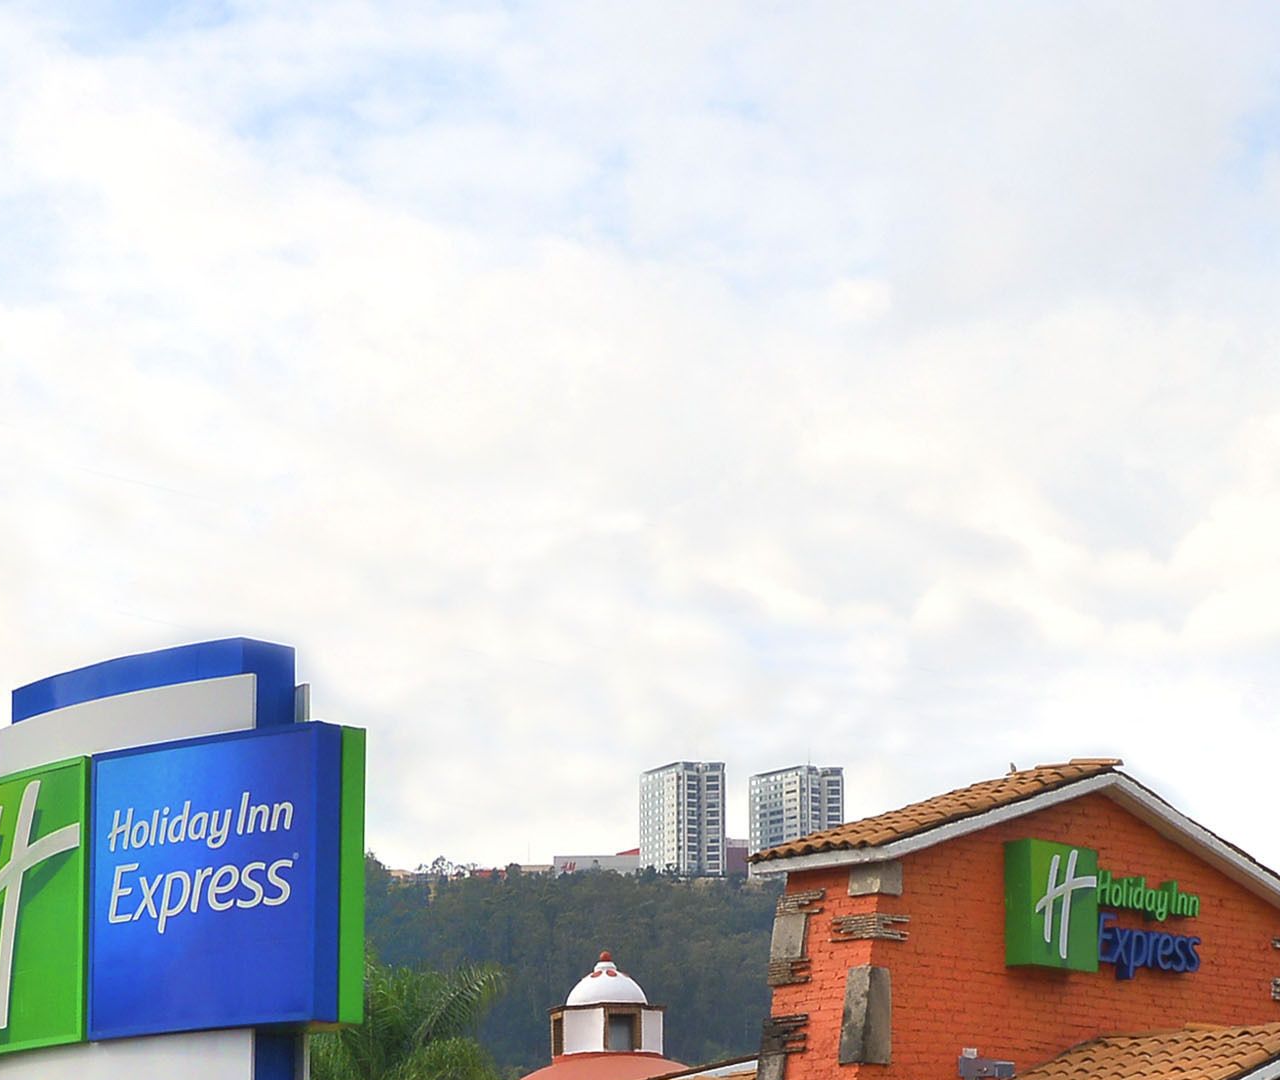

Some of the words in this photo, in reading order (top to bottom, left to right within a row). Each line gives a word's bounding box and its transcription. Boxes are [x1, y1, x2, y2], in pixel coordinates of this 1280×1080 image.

[108, 801, 233, 850] Holiday
[237, 792, 294, 835] Inn
[108, 858, 294, 934] Express
[1097, 869, 1168, 921] Holiday
[1169, 881, 1200, 917] Inn
[1098, 912, 1201, 979] Express
